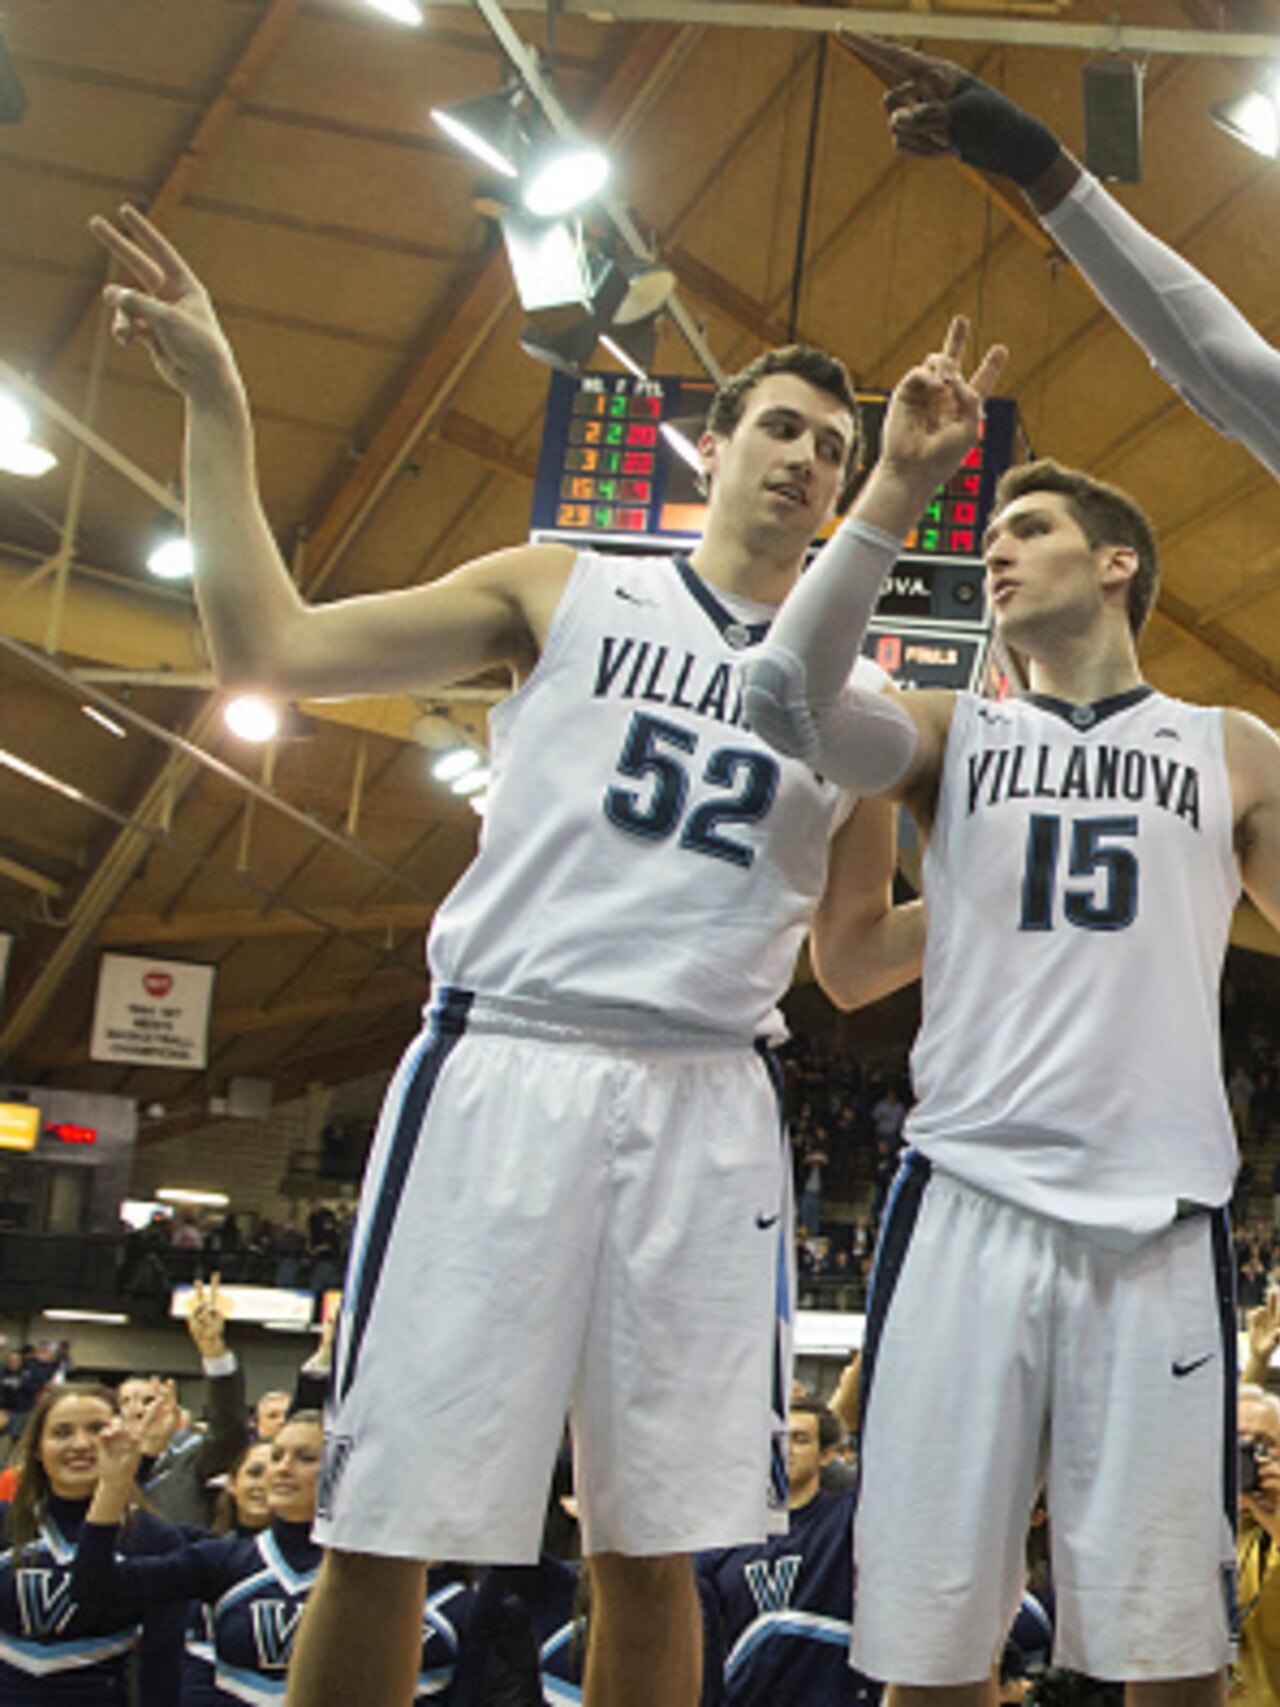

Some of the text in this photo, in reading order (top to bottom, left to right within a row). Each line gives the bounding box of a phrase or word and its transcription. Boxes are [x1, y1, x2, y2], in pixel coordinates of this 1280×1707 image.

[580, 448, 598, 471] 3
[584, 422, 601, 444] 2
[606, 422, 622, 445] 2
[603, 711, 780, 869] 52
[967, 745, 1201, 831] VILLANOVA
[1018, 813, 1139, 931] 15
